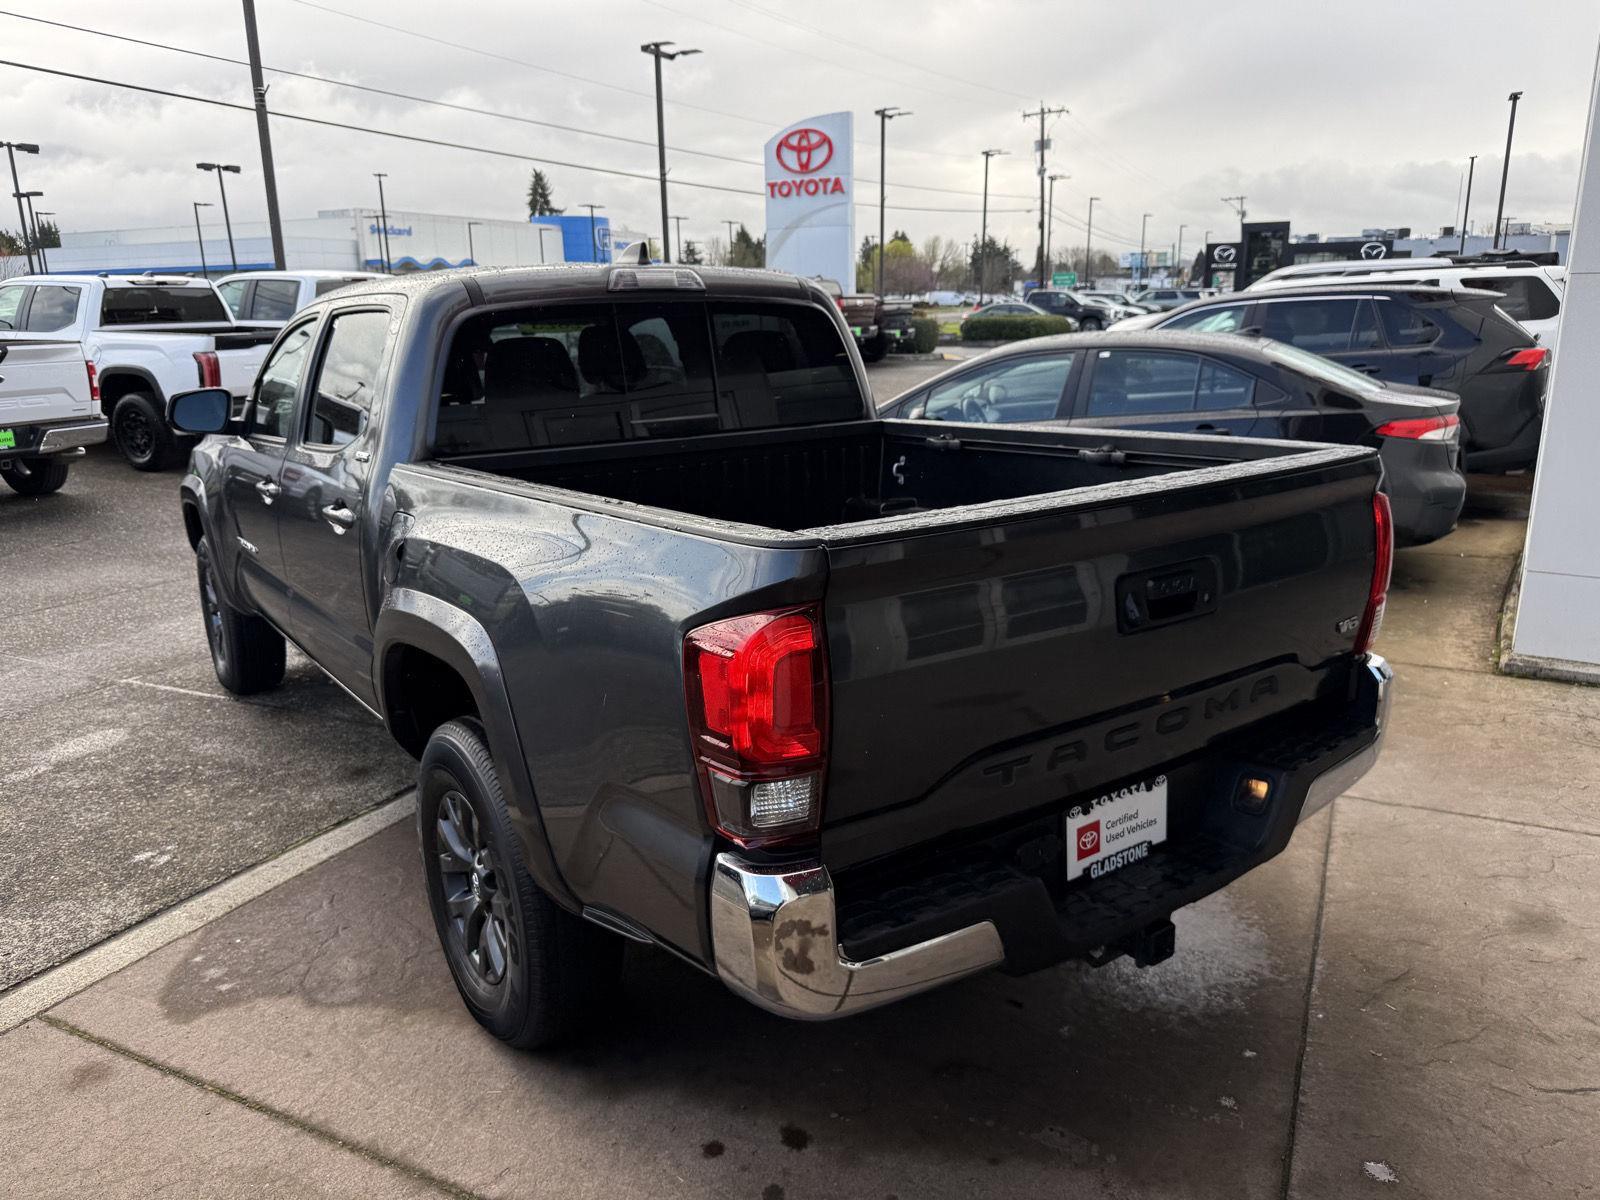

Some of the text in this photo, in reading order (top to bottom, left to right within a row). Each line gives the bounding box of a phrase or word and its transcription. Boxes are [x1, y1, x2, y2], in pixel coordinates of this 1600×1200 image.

[767, 177, 845, 199] TOYOTA
[982, 674, 1280, 787] TACOMA
[1091, 782, 1147, 810] TOYOTA
[1105, 810, 1139, 830] Certified
[1105, 817, 1158, 844] Used Vehicles
[1090, 842, 1149, 879] GLADSTONE
